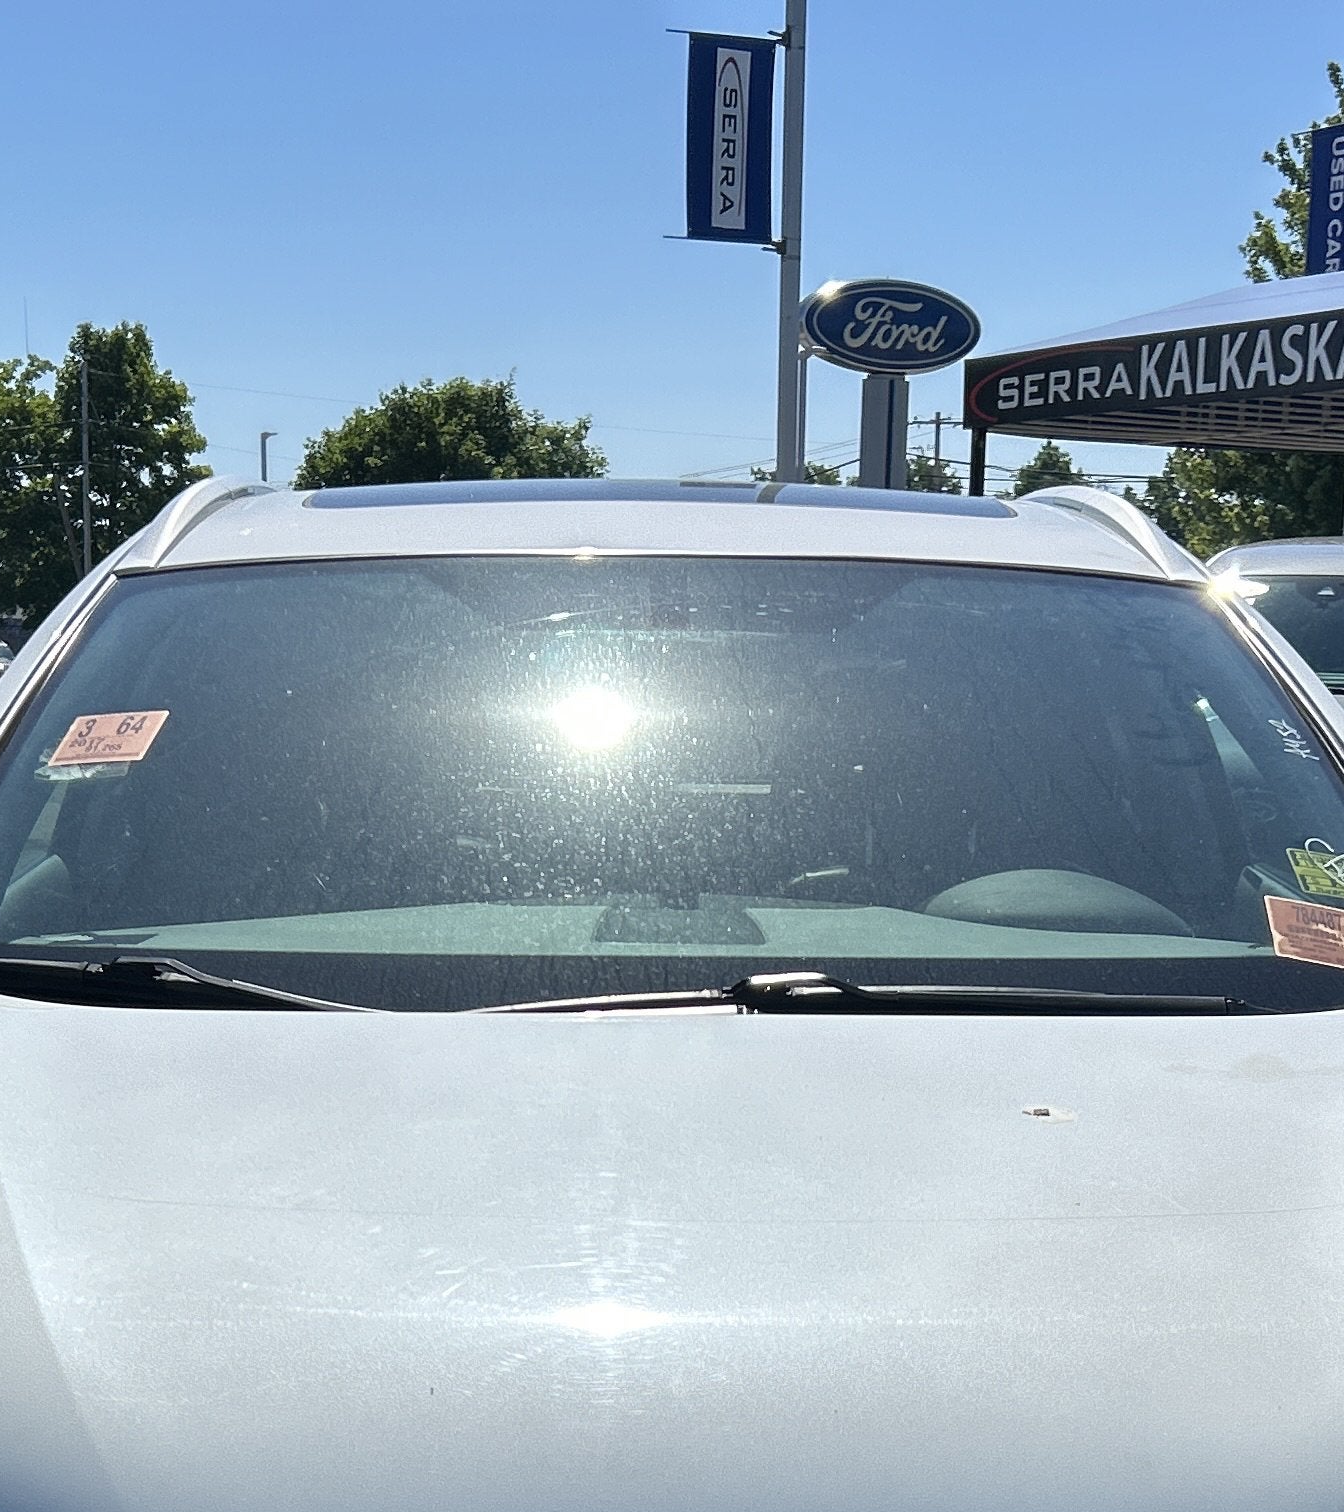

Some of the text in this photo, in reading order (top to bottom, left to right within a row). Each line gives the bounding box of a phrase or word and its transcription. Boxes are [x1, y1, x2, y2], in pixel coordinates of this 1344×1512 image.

[719, 86, 738, 215] SERRA
[1323, 218, 1344, 272] CAR
[843, 296, 948, 352] Ford
[997, 362, 1133, 410] SERRA
[77, 715, 149, 738] 3 64
[1292, 905, 1343, 931] 784487
